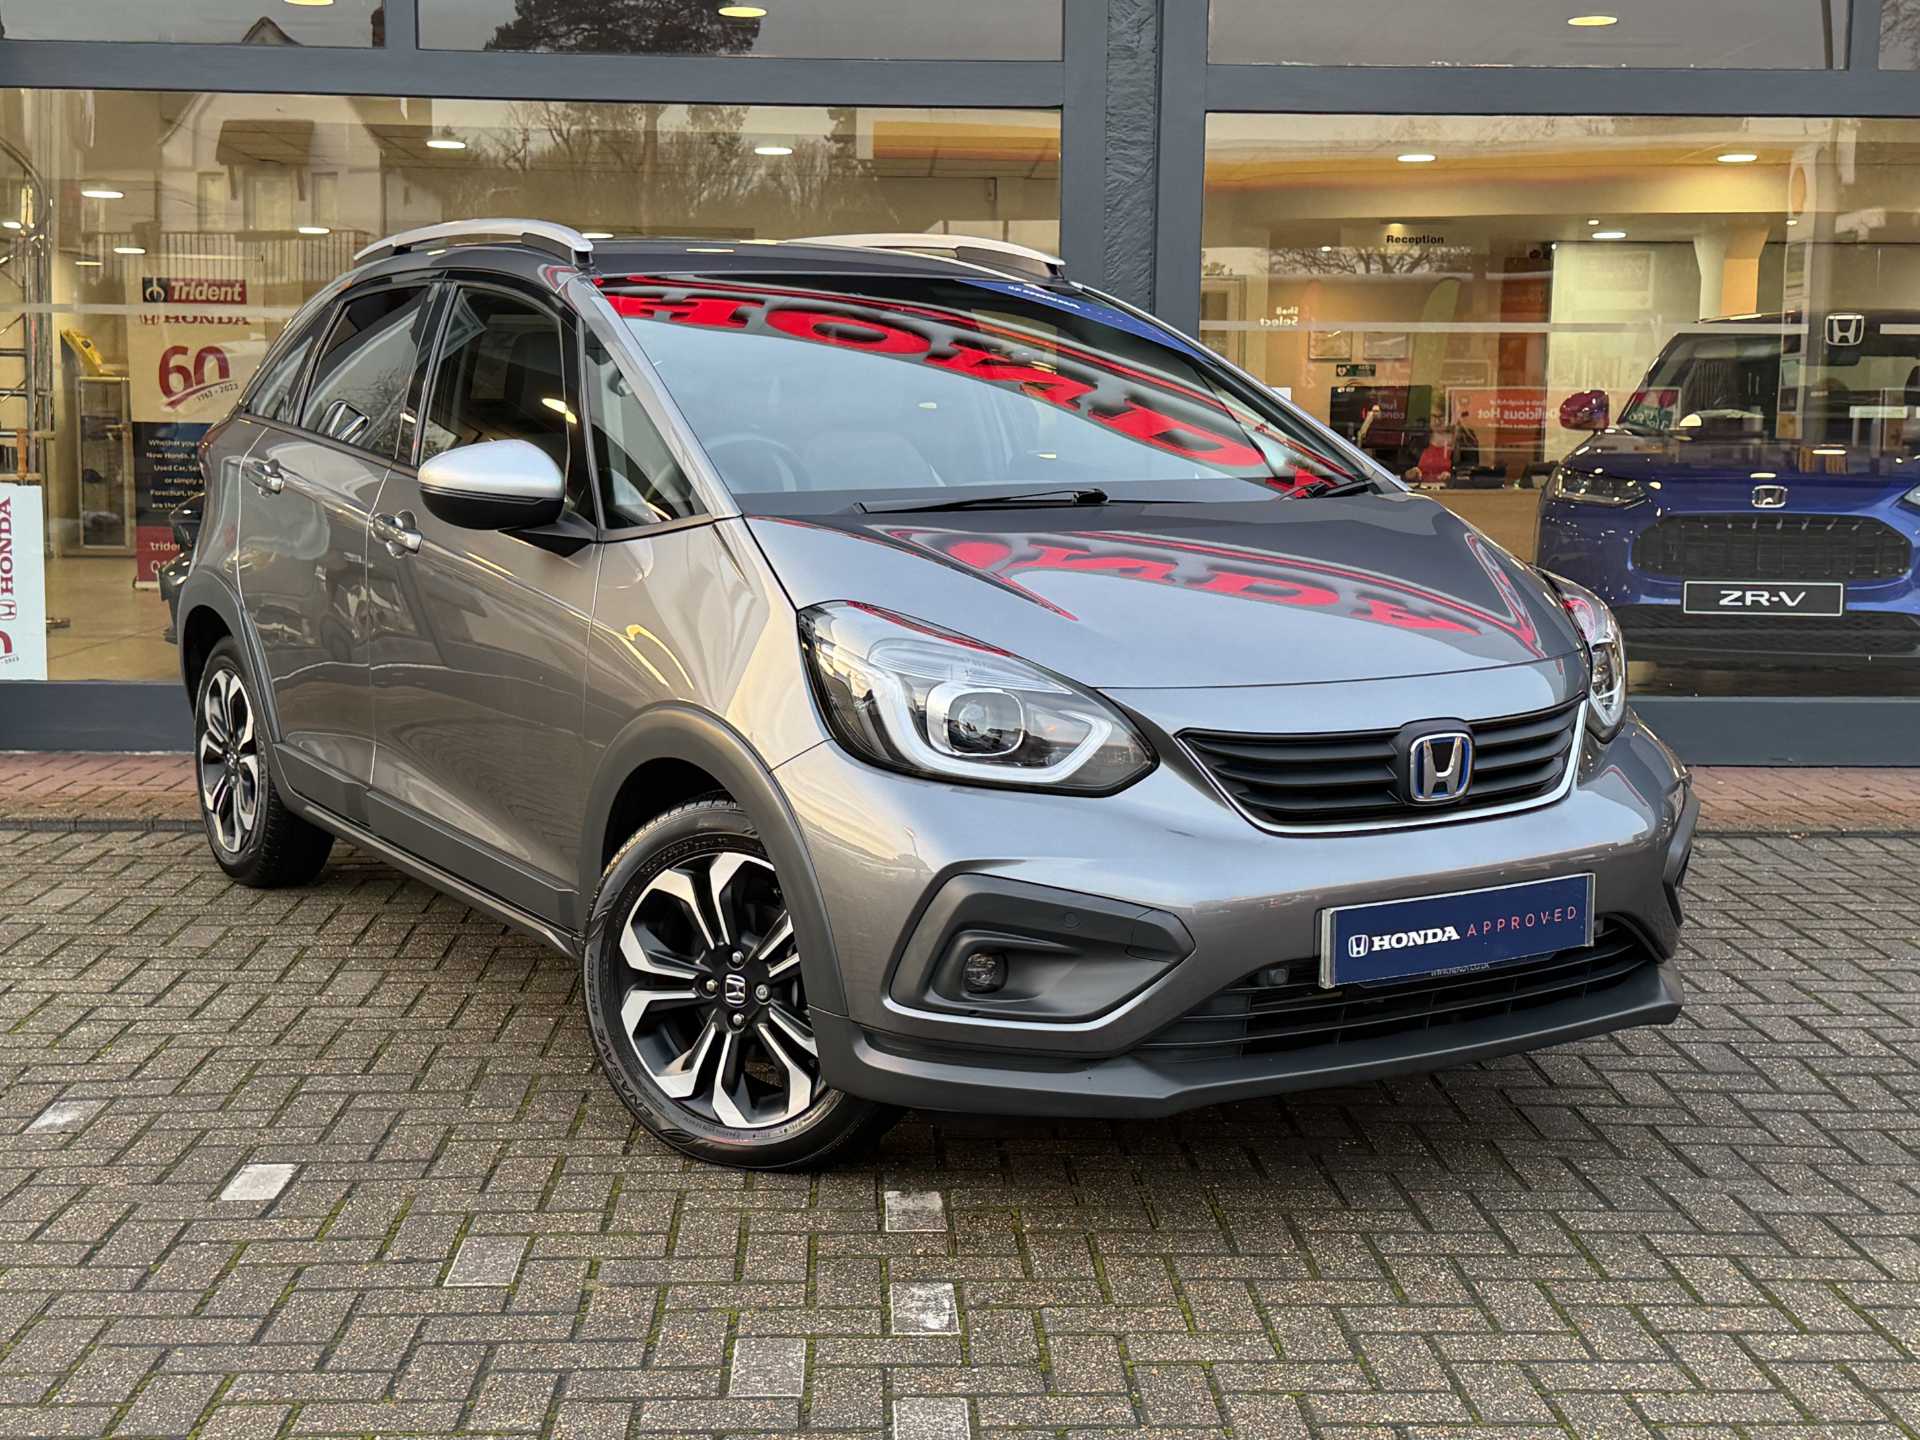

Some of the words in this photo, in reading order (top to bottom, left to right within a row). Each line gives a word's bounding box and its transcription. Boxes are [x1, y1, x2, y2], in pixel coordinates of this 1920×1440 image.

[1386, 235, 1445, 245] Reception
[171, 281, 242, 301] Trident
[0, 497, 13, 595] HONDA
[1719, 590, 1806, 607] ZR-V
[1371, 926, 1460, 951] HONDA
[1467, 906, 1577, 936] APPROVED
